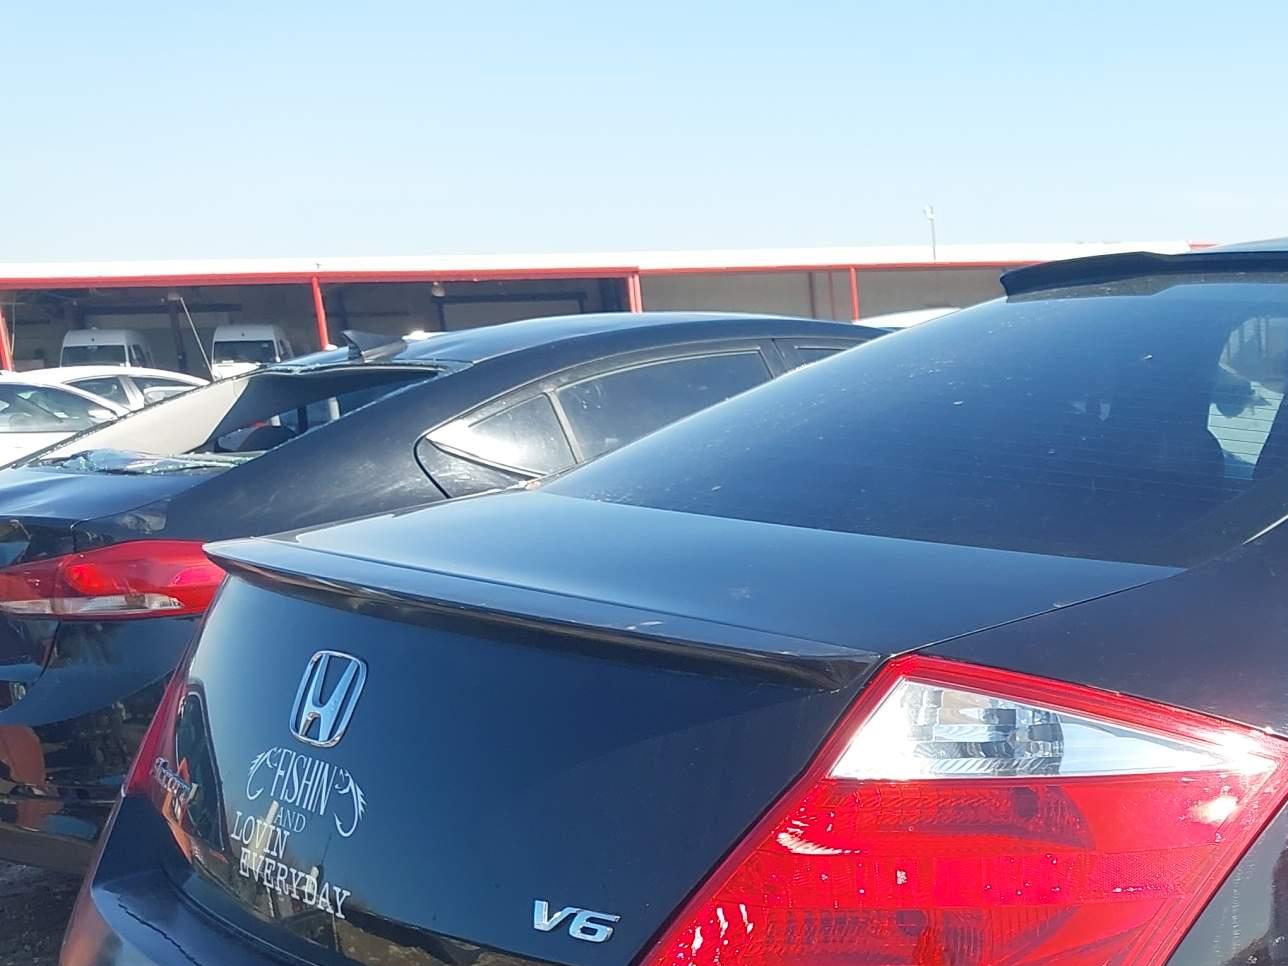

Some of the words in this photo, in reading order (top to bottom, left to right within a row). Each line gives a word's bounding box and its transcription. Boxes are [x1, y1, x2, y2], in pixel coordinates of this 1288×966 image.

[270, 748, 338, 815] FISHIN
[231, 810, 290, 859] LOVIN
[273, 806, 306, 832] AND
[239, 846, 351, 919] EVERYDAY
[533, 899, 621, 943] V6
